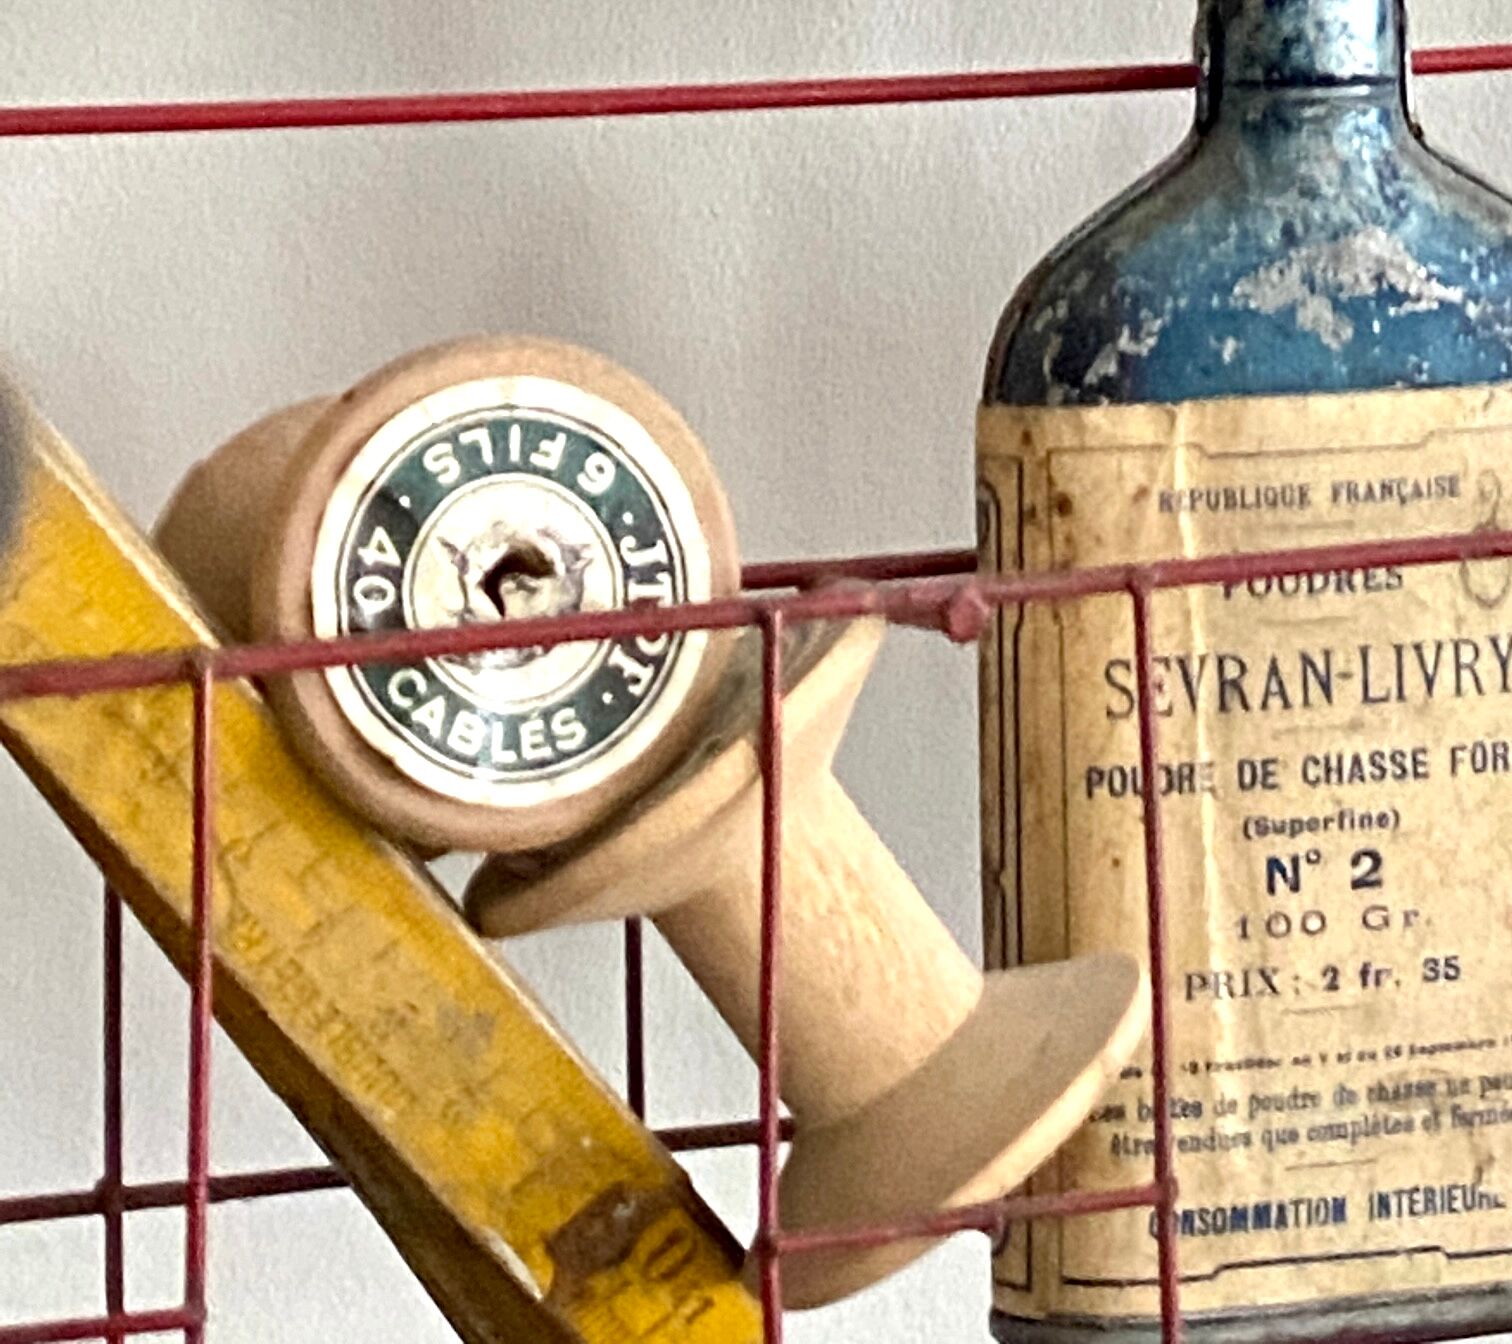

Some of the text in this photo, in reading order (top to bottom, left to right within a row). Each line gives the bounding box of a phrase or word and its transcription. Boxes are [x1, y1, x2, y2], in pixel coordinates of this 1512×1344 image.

[423, 423, 617, 496] 6 FILS
[1236, 756, 1280, 792] DE
[1301, 746, 1431, 789] CHASSE
[1241, 807, 1401, 841] (Superfine)
[1266, 847, 1385, 896] N° 2
[1237, 909, 1328, 941] 100
[1320, 962, 1342, 993] 2
[1420, 953, 1463, 985] 35
